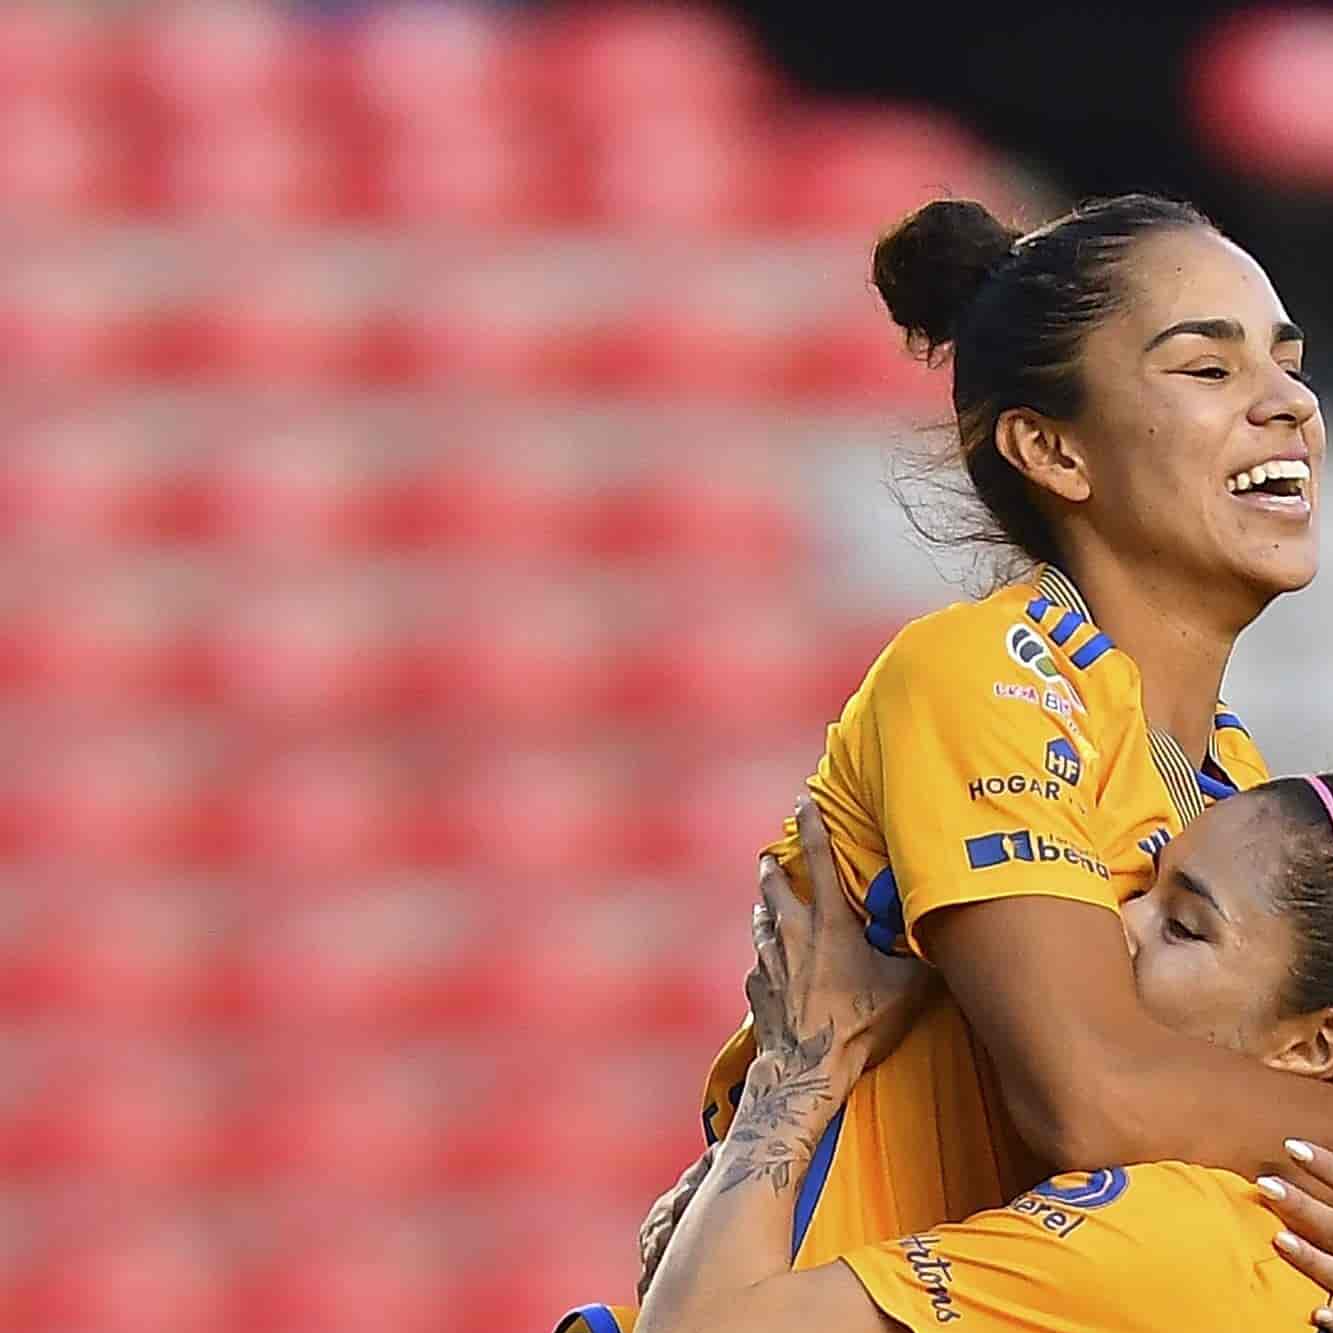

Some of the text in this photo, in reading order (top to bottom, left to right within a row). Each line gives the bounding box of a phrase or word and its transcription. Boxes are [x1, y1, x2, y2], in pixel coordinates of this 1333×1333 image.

[1048, 750, 1079, 781] HF
[968, 775, 1061, 801] HOGAR
[1012, 1196, 1088, 1238] erel
